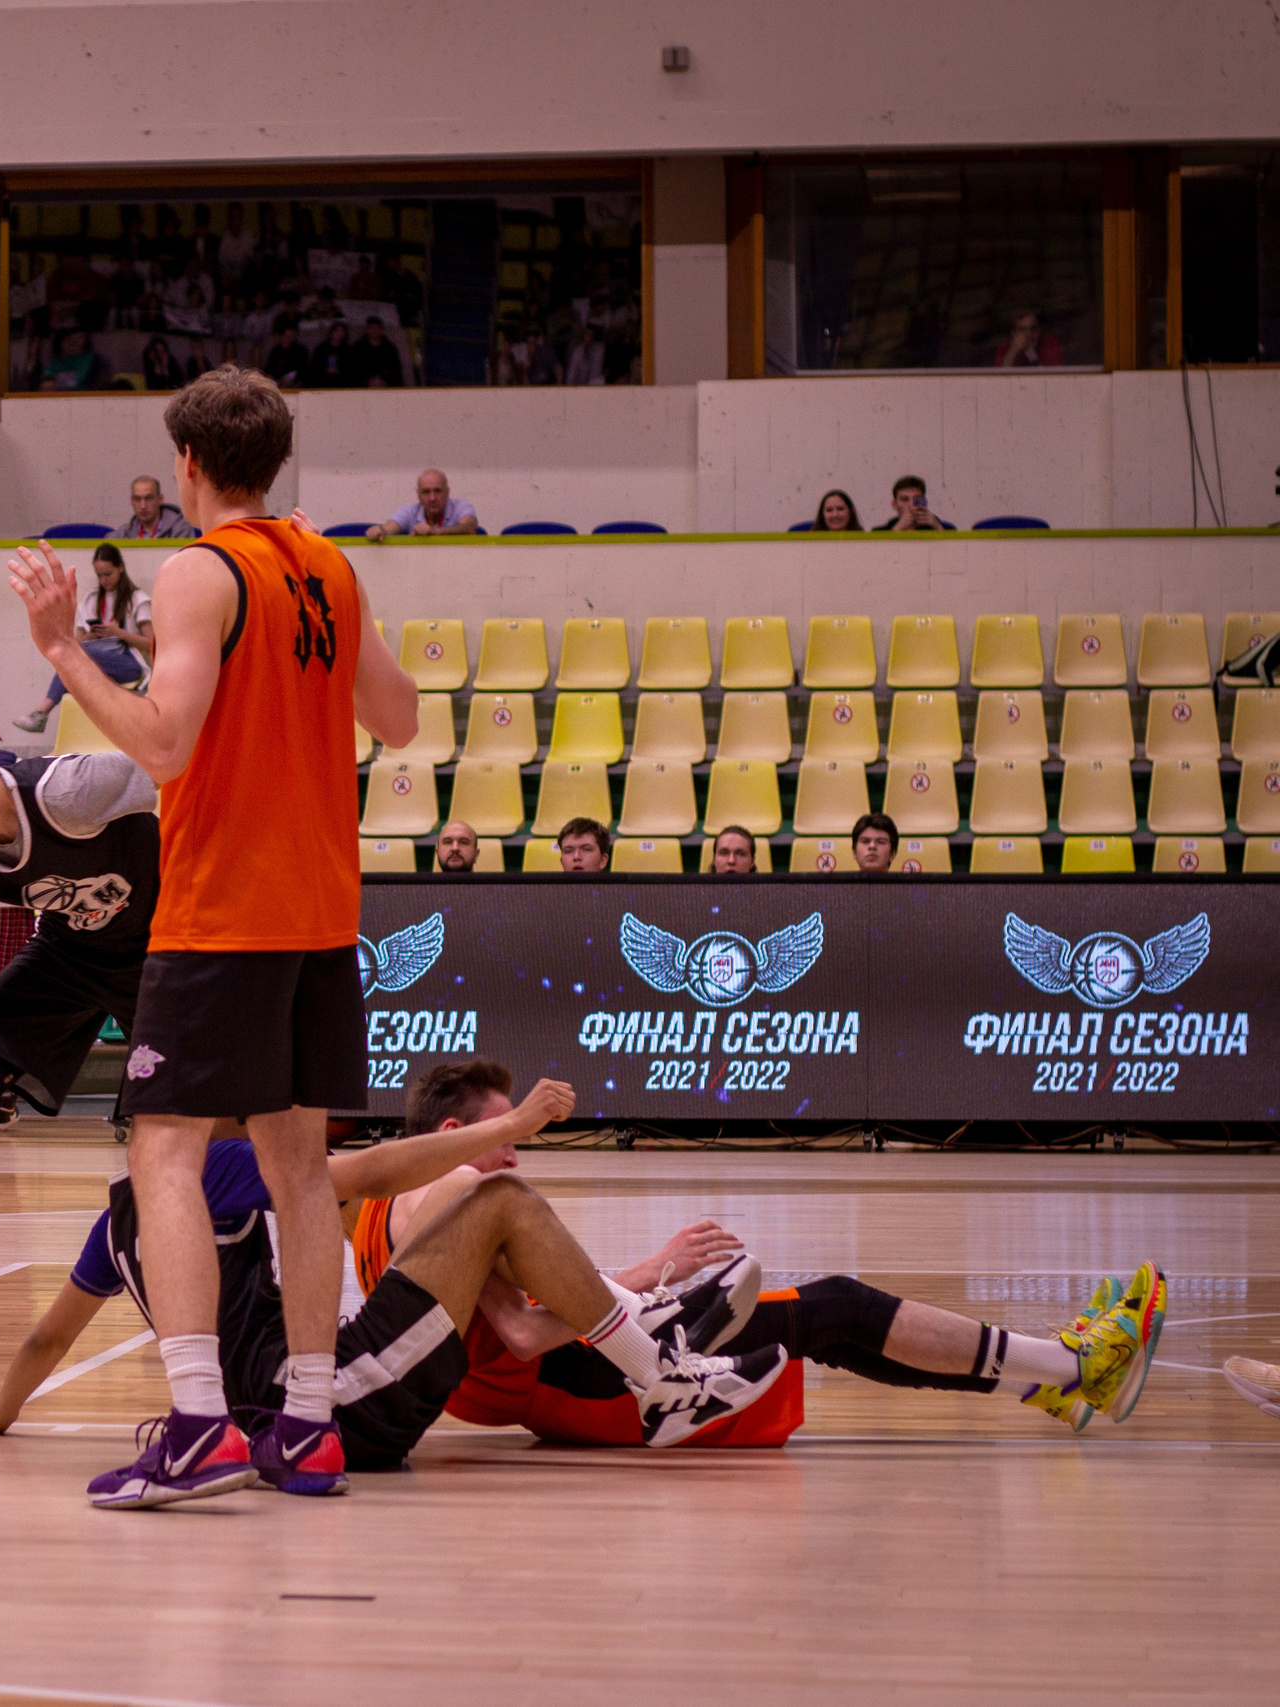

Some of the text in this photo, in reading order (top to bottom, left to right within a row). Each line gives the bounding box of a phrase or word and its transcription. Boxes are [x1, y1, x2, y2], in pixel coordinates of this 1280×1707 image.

[365, 1010, 477, 1052] ЕЗОНА
[578, 1011, 860, 1054] ФИНАЛ СЕЗОНА
[963, 1012, 1249, 1056] ФИНАЛ СЕЗОНА
